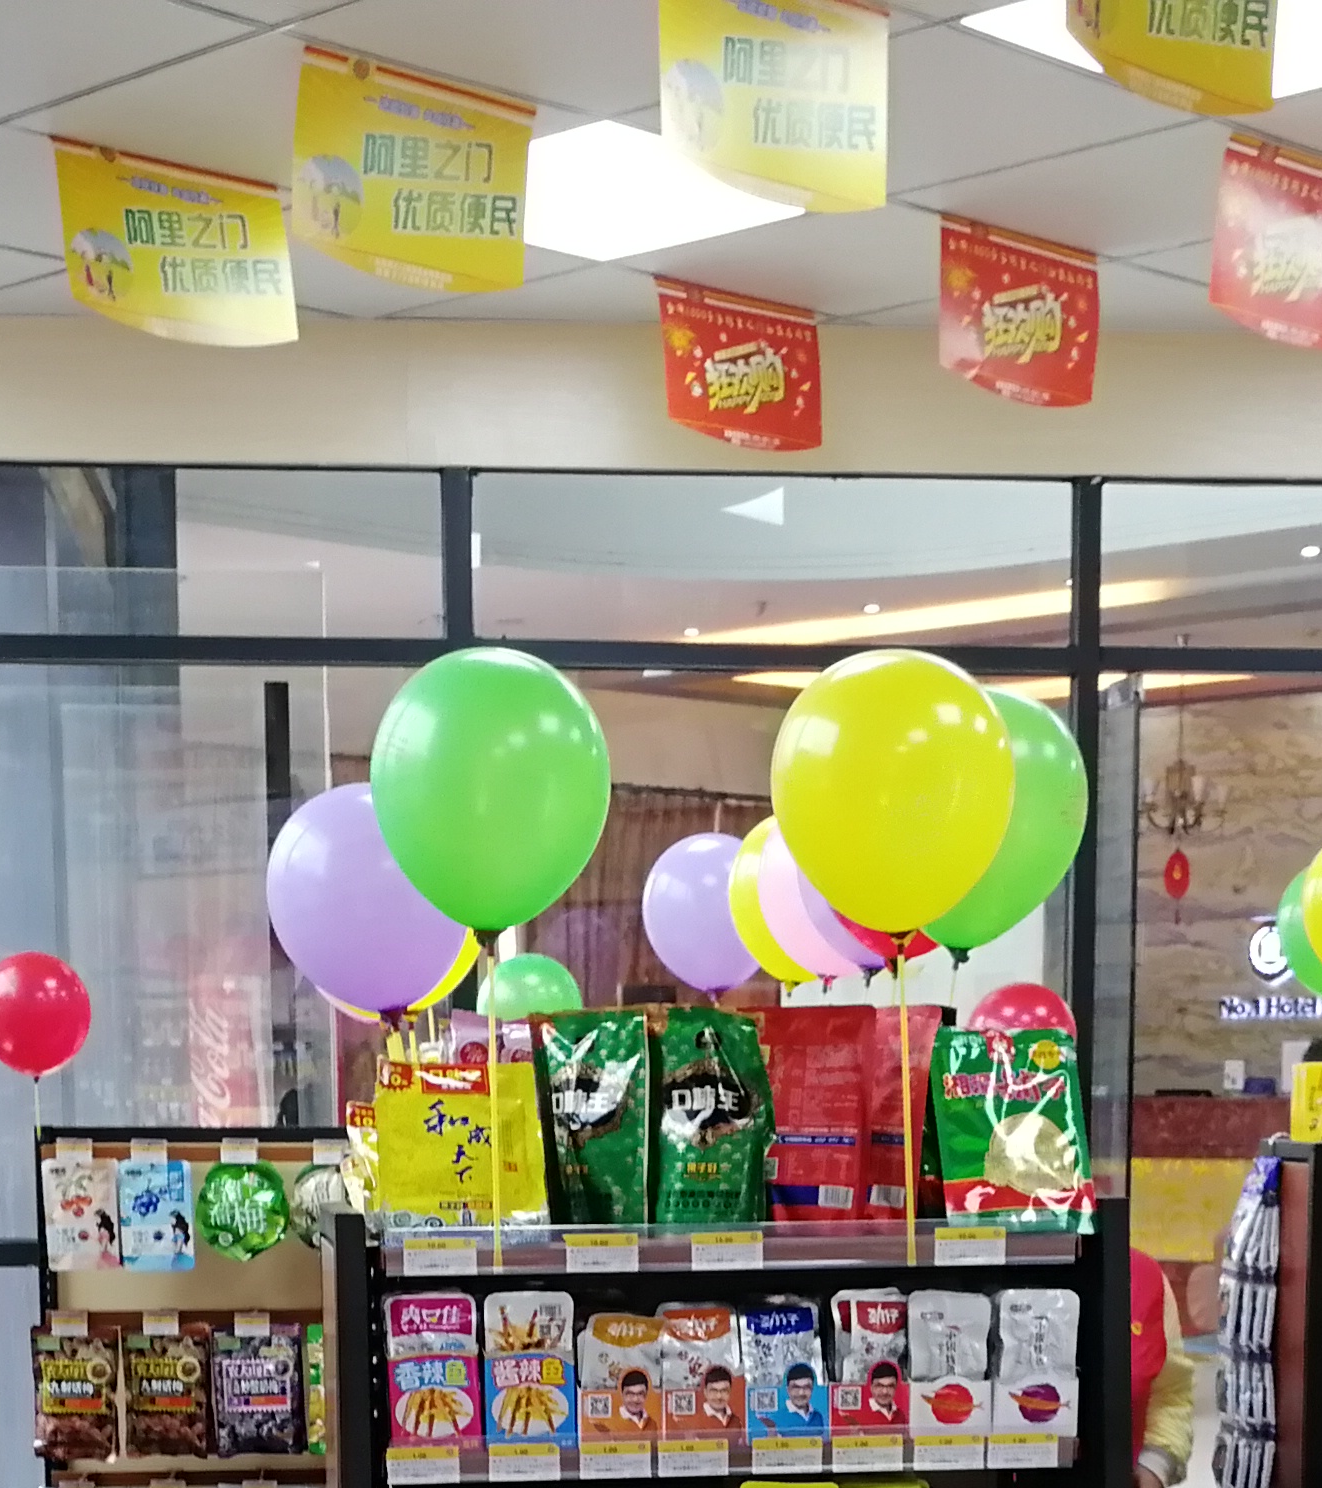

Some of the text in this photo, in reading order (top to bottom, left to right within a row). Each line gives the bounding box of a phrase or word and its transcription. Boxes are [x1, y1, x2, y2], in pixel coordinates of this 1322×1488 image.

[1147, 0, 1269, 48] 优质便民
[722, 34, 849, 90] 阿里之门
[752, 97, 876, 152] 优质便民
[363, 132, 494, 184] 阿里之门
[124, 208, 250, 250] 阿里之门
[393, 188, 518, 237] 优质便民
[159, 255, 282, 296] 优质便民
